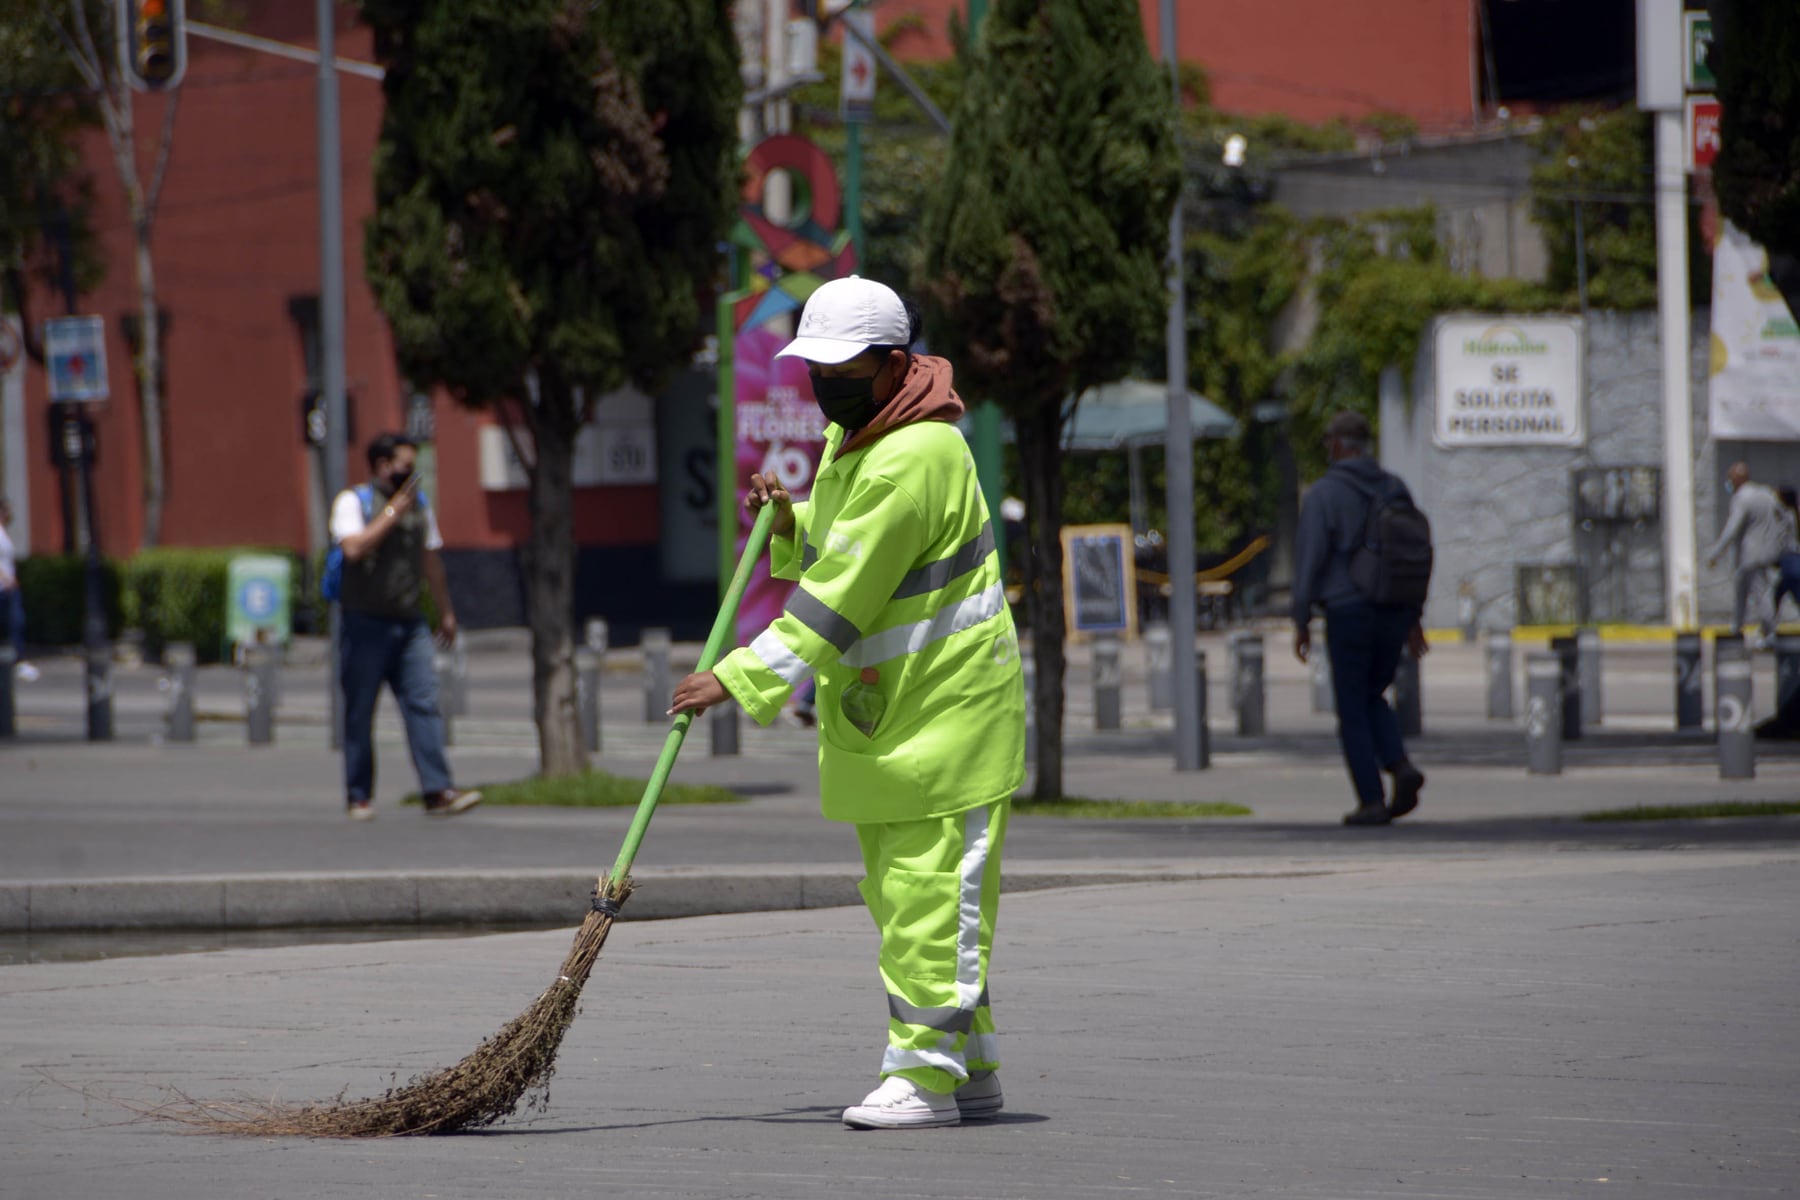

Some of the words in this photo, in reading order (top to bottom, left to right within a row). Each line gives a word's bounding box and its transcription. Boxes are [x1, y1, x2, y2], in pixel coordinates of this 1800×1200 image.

[1491, 364, 1519, 383] SE
[1454, 389, 1554, 409] SOLICITA
[738, 416, 824, 442] FLORES
[1449, 415, 1564, 433] PERSONAL
